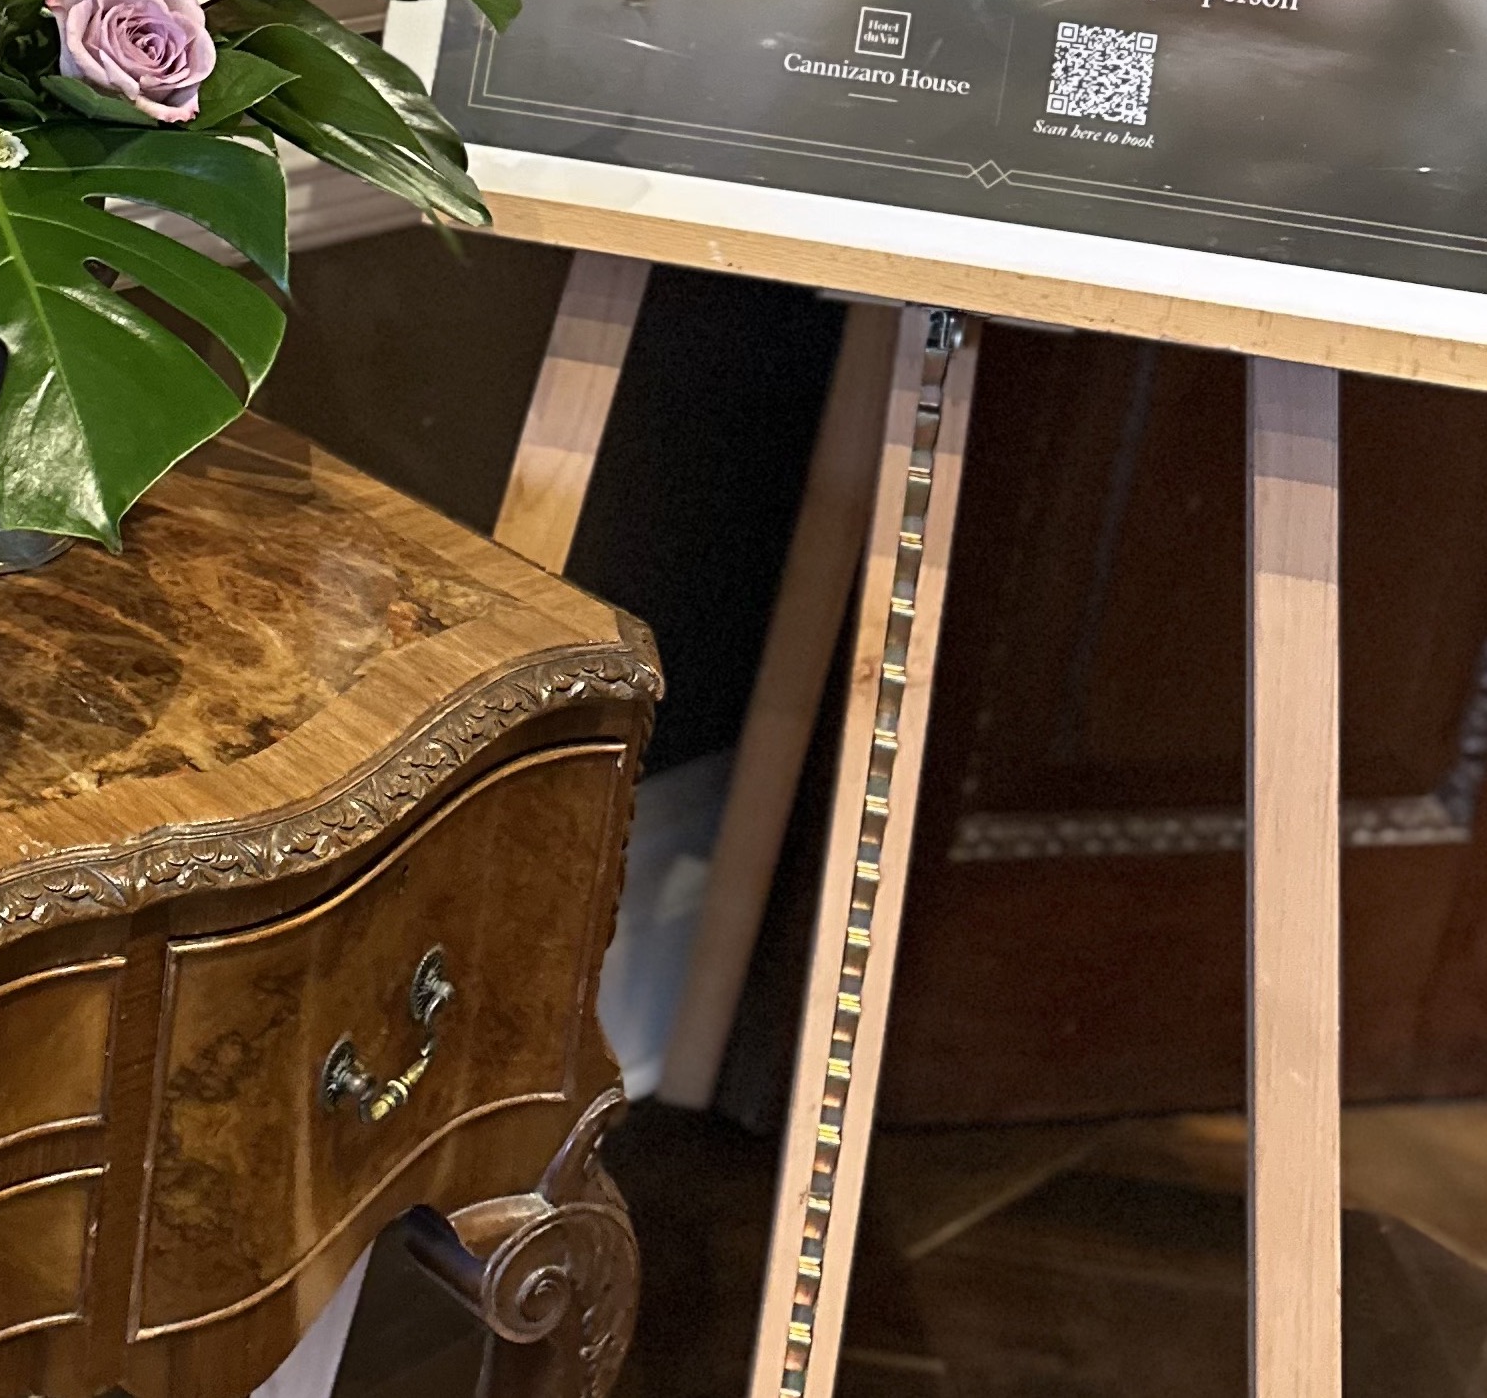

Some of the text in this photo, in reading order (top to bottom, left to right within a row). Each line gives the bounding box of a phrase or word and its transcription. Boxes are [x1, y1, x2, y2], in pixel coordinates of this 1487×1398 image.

[867, 19, 900, 33] Hotel
[783, 52, 971, 96] Cannizaro House
[1033, 119, 1155, 148] Scan here to book
